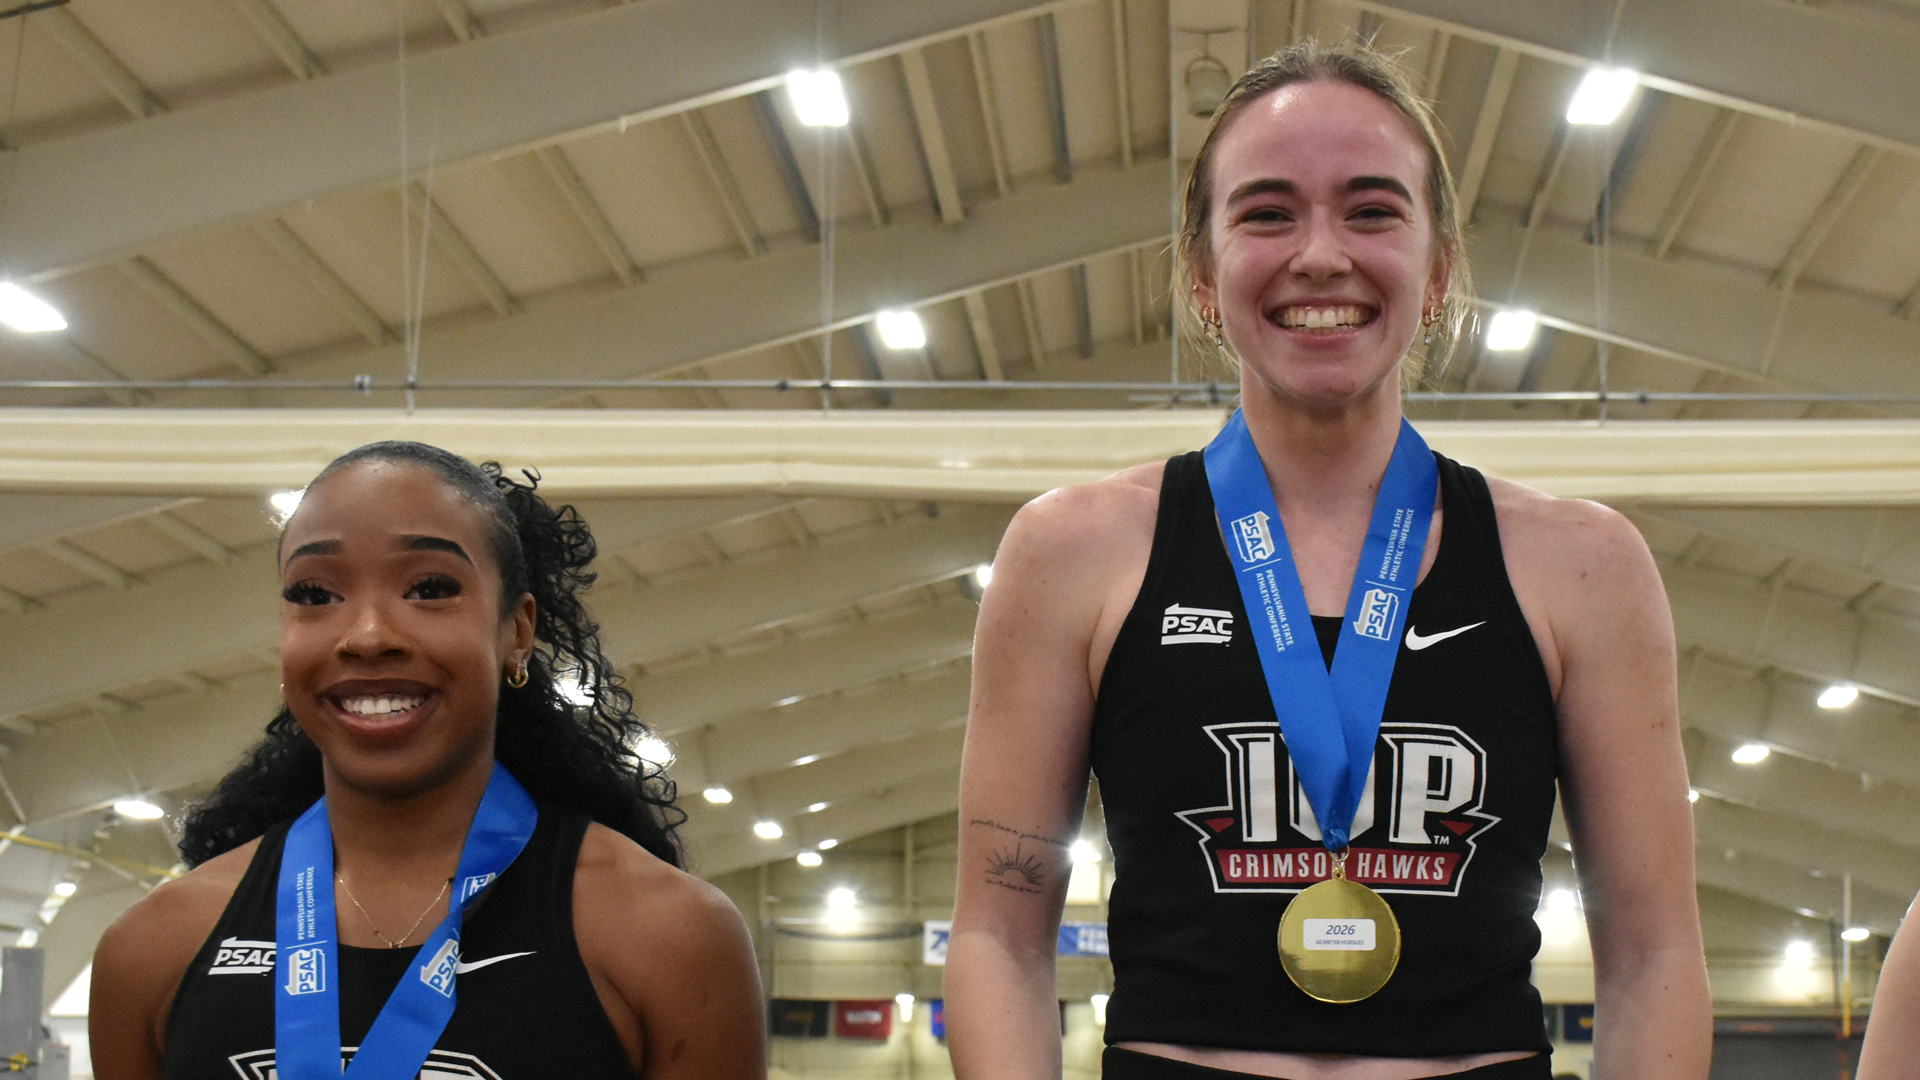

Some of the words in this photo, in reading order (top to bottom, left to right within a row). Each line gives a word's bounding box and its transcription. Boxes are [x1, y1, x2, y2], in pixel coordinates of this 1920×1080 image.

[1241, 515, 1267, 559] PSAC
[1379, 529, 1399, 580] PENNSYLVANIA
[1393, 508, 1404, 529] STATE
[1389, 548, 1404, 582] ATHLETIC
[1401, 508, 1415, 549] CONFERENCE
[1162, 616, 1233, 635] PSAC
[1256, 573, 1271, 605] ATHLETIC
[1265, 606, 1285, 652] CONFERENCE
[1265, 569, 1287, 623] PENNSYLVANIA
[1281, 623, 1294, 646] STATE
[1365, 592, 1390, 637] PSAC
[306, 866, 315, 907] CONFERENCE
[1357, 853, 1445, 881] HAWKS
[297, 892, 305, 940] PENNSYLVANIA
[307, 909, 316, 938] ATHLETIC
[1326, 924, 1355, 935] 2026
[213, 949, 277, 966] PSAC
[299, 951, 315, 993] PSAC
